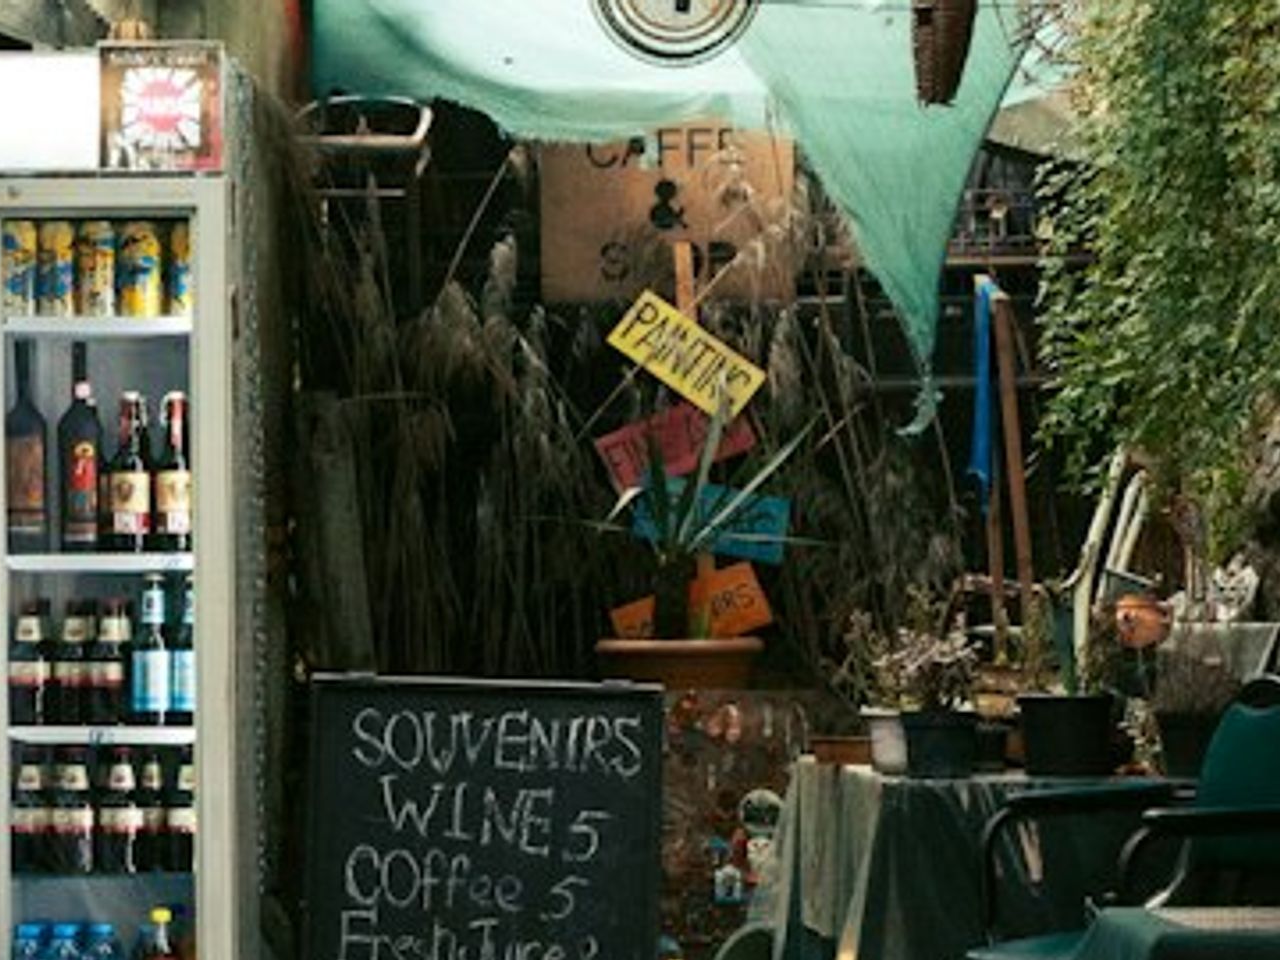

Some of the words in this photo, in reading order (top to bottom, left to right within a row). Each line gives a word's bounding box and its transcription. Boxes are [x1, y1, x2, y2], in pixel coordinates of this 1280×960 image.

[651, 180, 688, 229] &
[600, 241, 737, 282] SP
[352, 707, 642, 777] SOUVENIRS
[379, 774, 554, 857] WINE
[562, 810, 612, 862] 5
[540, 874, 591, 921] 5
